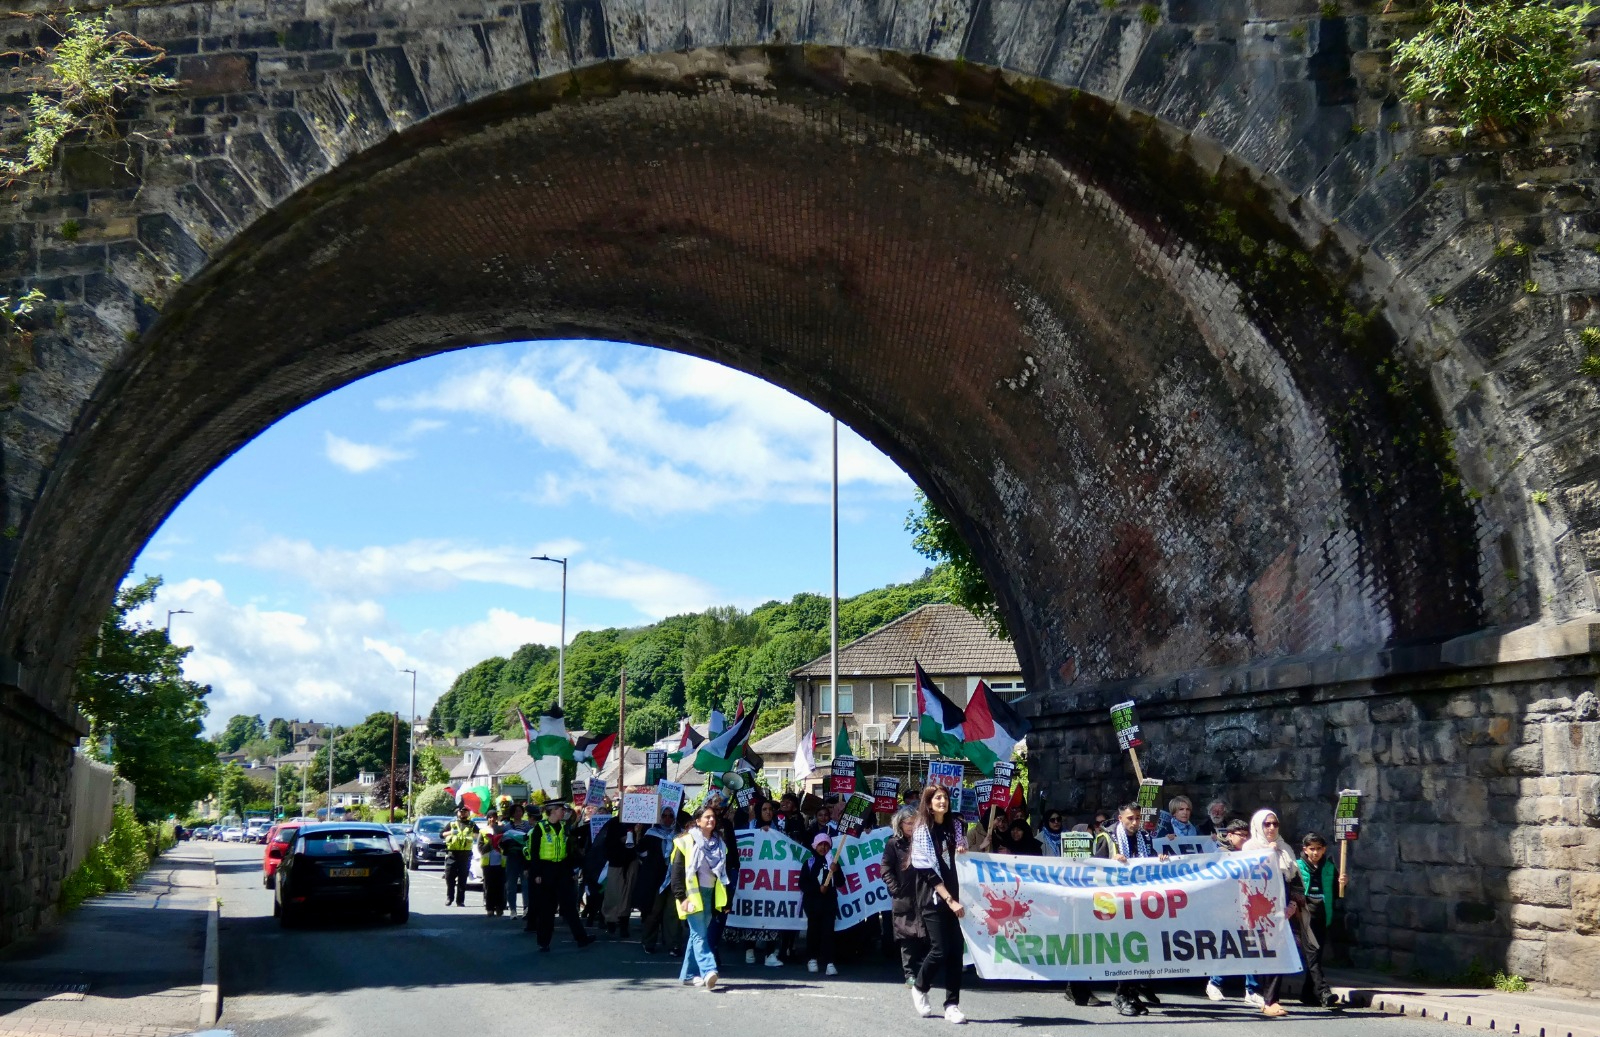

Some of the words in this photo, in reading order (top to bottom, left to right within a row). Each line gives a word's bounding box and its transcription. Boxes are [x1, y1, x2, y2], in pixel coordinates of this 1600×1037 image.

[832, 769, 855, 777] PALESTINE
[930, 762, 962, 776] TELEDYNE
[995, 768, 1011, 777] EEDOM
[929, 773, 960, 788] STOP
[994, 778, 1011, 787] ESTINE
[875, 790, 897, 798] PALESTINE
[976, 785, 992, 793] FREED
[977, 795, 990, 803] PALES
[842, 813, 864, 826] PALESTINE
[1064, 839, 1090, 849] FREEDOM
[759, 840, 787, 861] AS
[970, 858, 1097, 888] TELEDYNE
[1103, 855, 1273, 888] TECHNOLOGIES
[864, 885, 892, 906] OCC
[1092, 889, 1188, 921] STOP
[993, 930, 1150, 966] ARMING
[1161, 928, 1277, 962] ISRAEL
[1104, 969, 1132, 977] Bradford
[1133, 969, 1155, 977] Friends
[1164, 967, 1191, 975] Palestine
